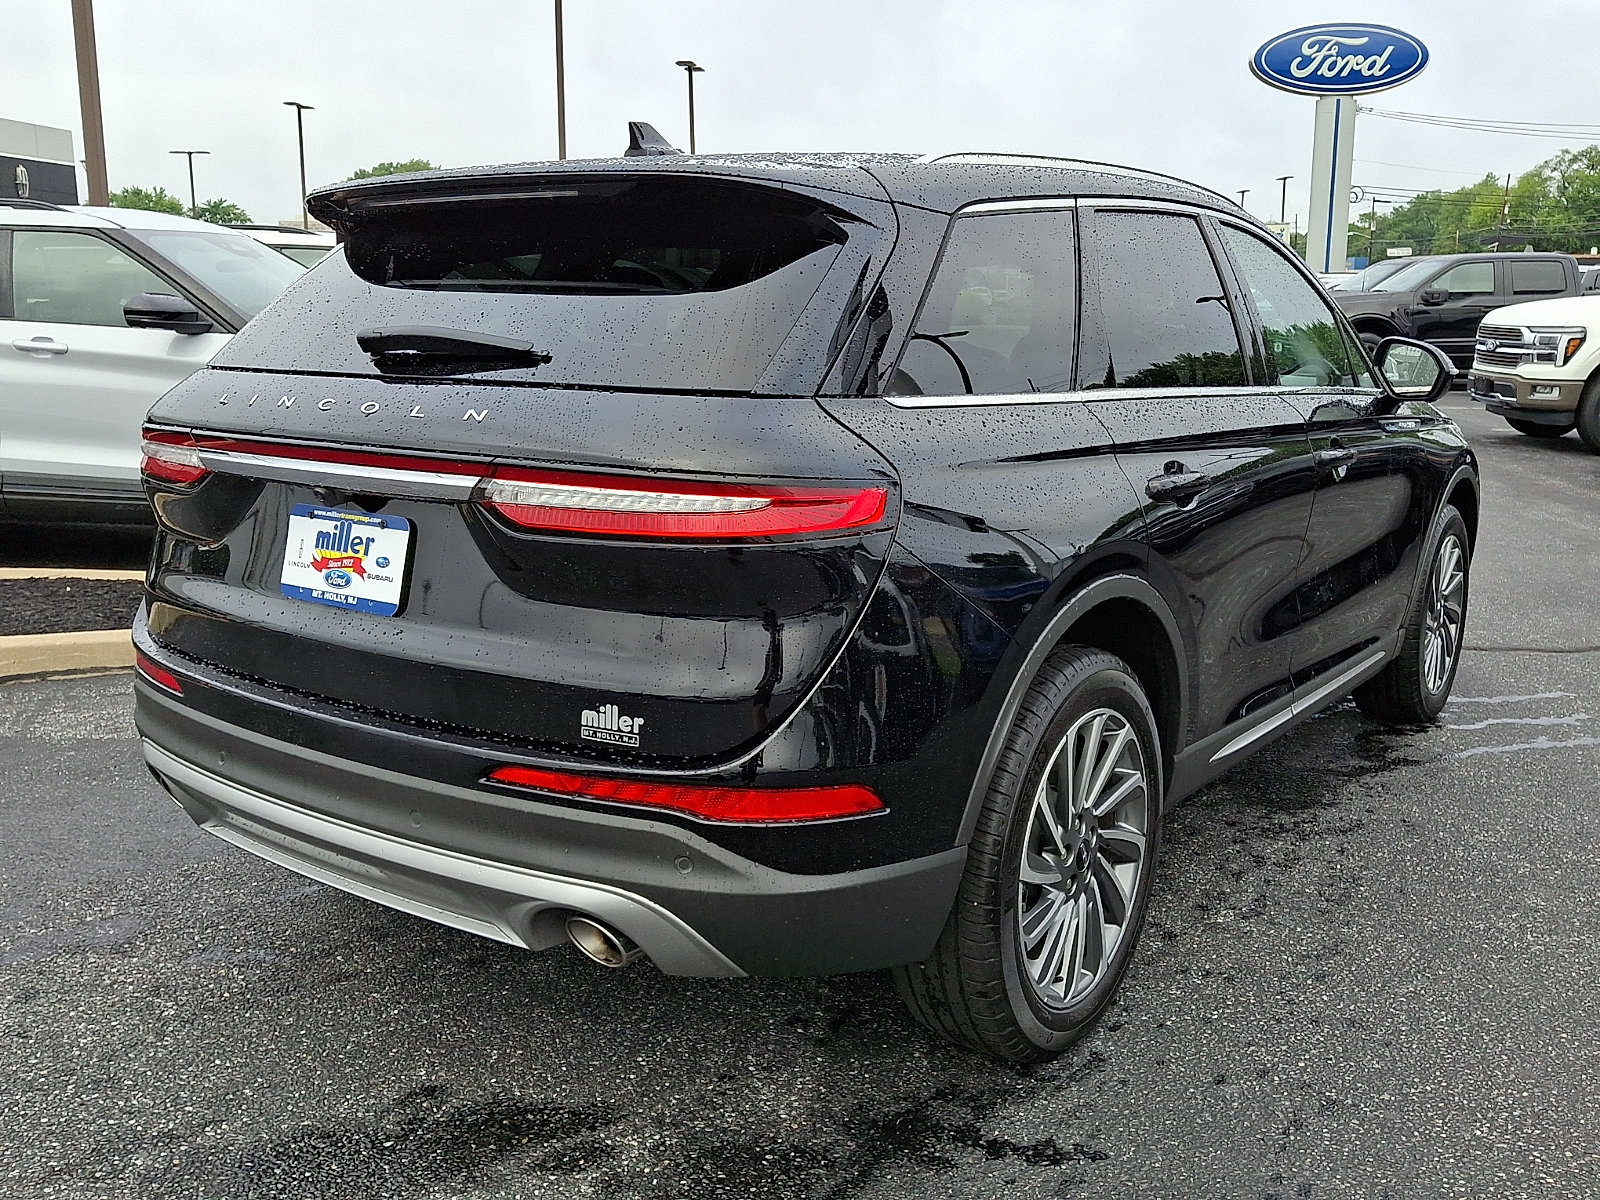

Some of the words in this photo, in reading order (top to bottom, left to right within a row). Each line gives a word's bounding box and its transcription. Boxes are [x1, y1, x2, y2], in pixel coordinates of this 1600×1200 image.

[1290, 36, 1395, 78] Ford
[219, 393, 489, 422] LINCOLN
[315, 520, 375, 556] miller
[288, 560, 310, 568] LINCOLN
[328, 570, 347, 586] Ford
[367, 573, 394, 583] SUBARU
[312, 589, 322, 599] MT.
[324, 591, 346, 604] HOLLY,
[347, 595, 358, 605] NJ
[581, 704, 644, 733] miller
